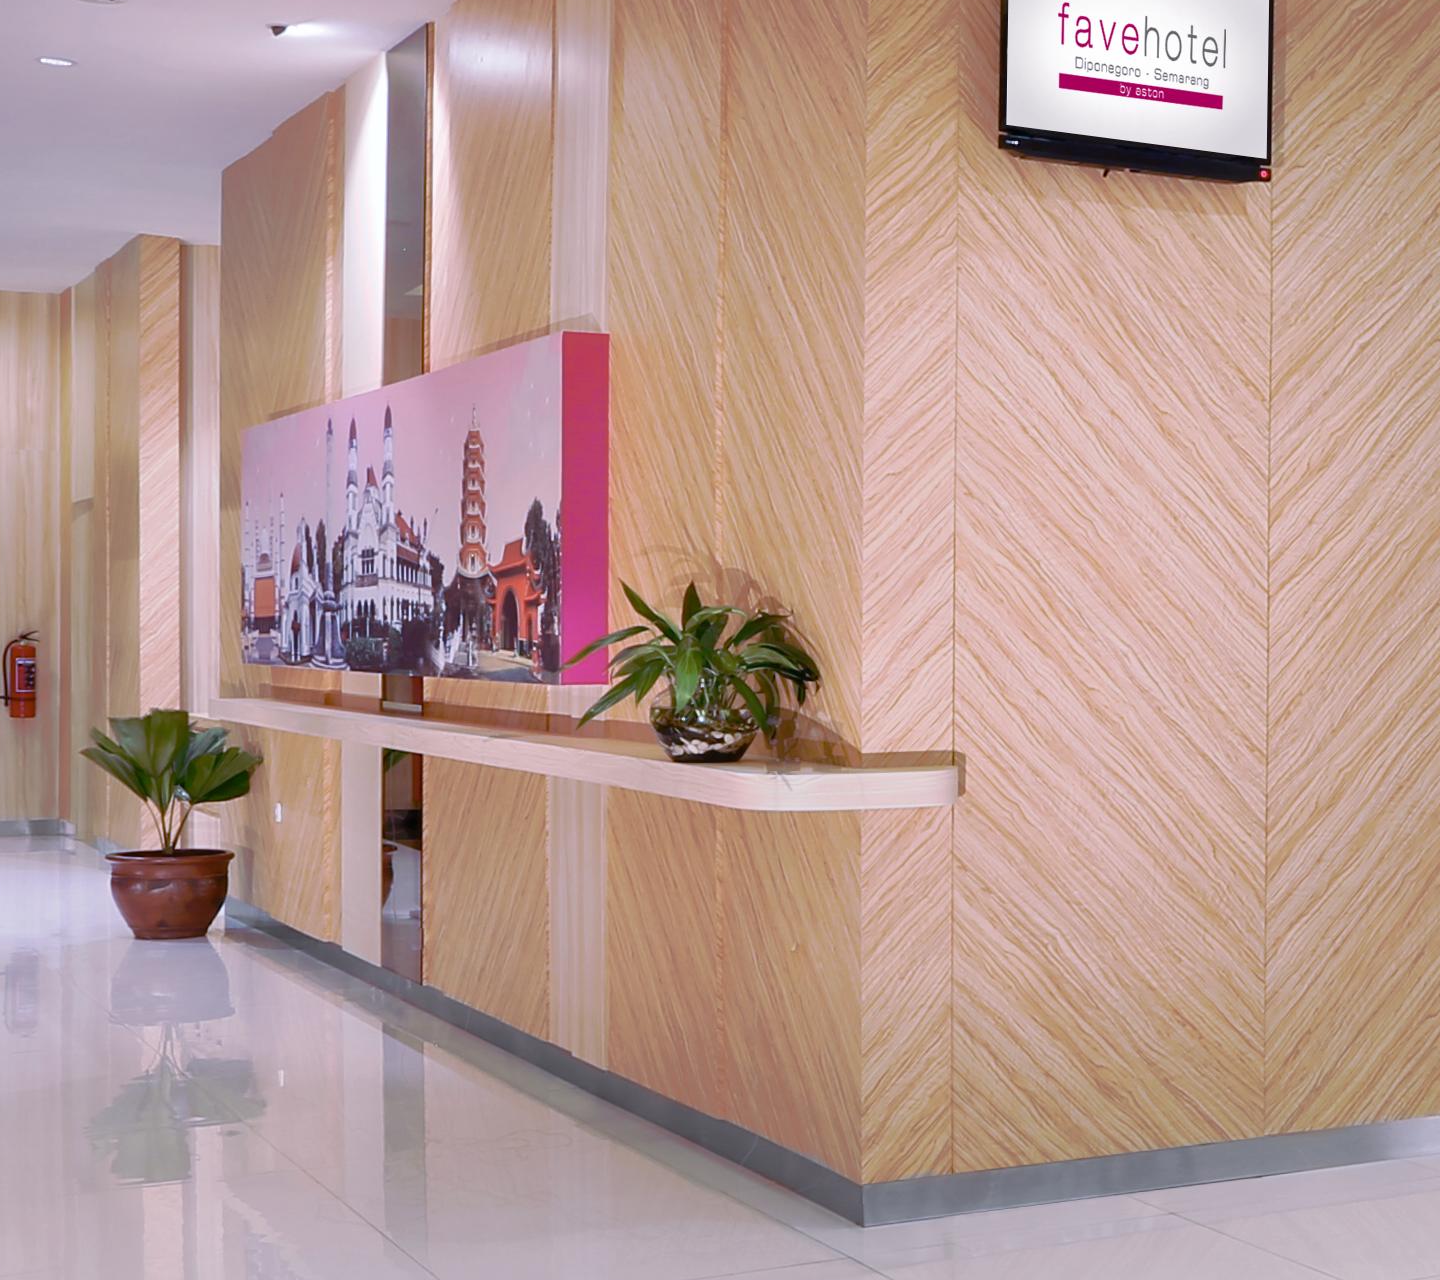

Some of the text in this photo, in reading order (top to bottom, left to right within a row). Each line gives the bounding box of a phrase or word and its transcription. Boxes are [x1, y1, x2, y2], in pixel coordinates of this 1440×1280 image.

[1057, 2, 1227, 69] favehotel
[1074, 56, 1142, 78] Diponegoro
[1153, 68, 1210, 89] Semarang
[1119, 83, 1165, 99] by aston
